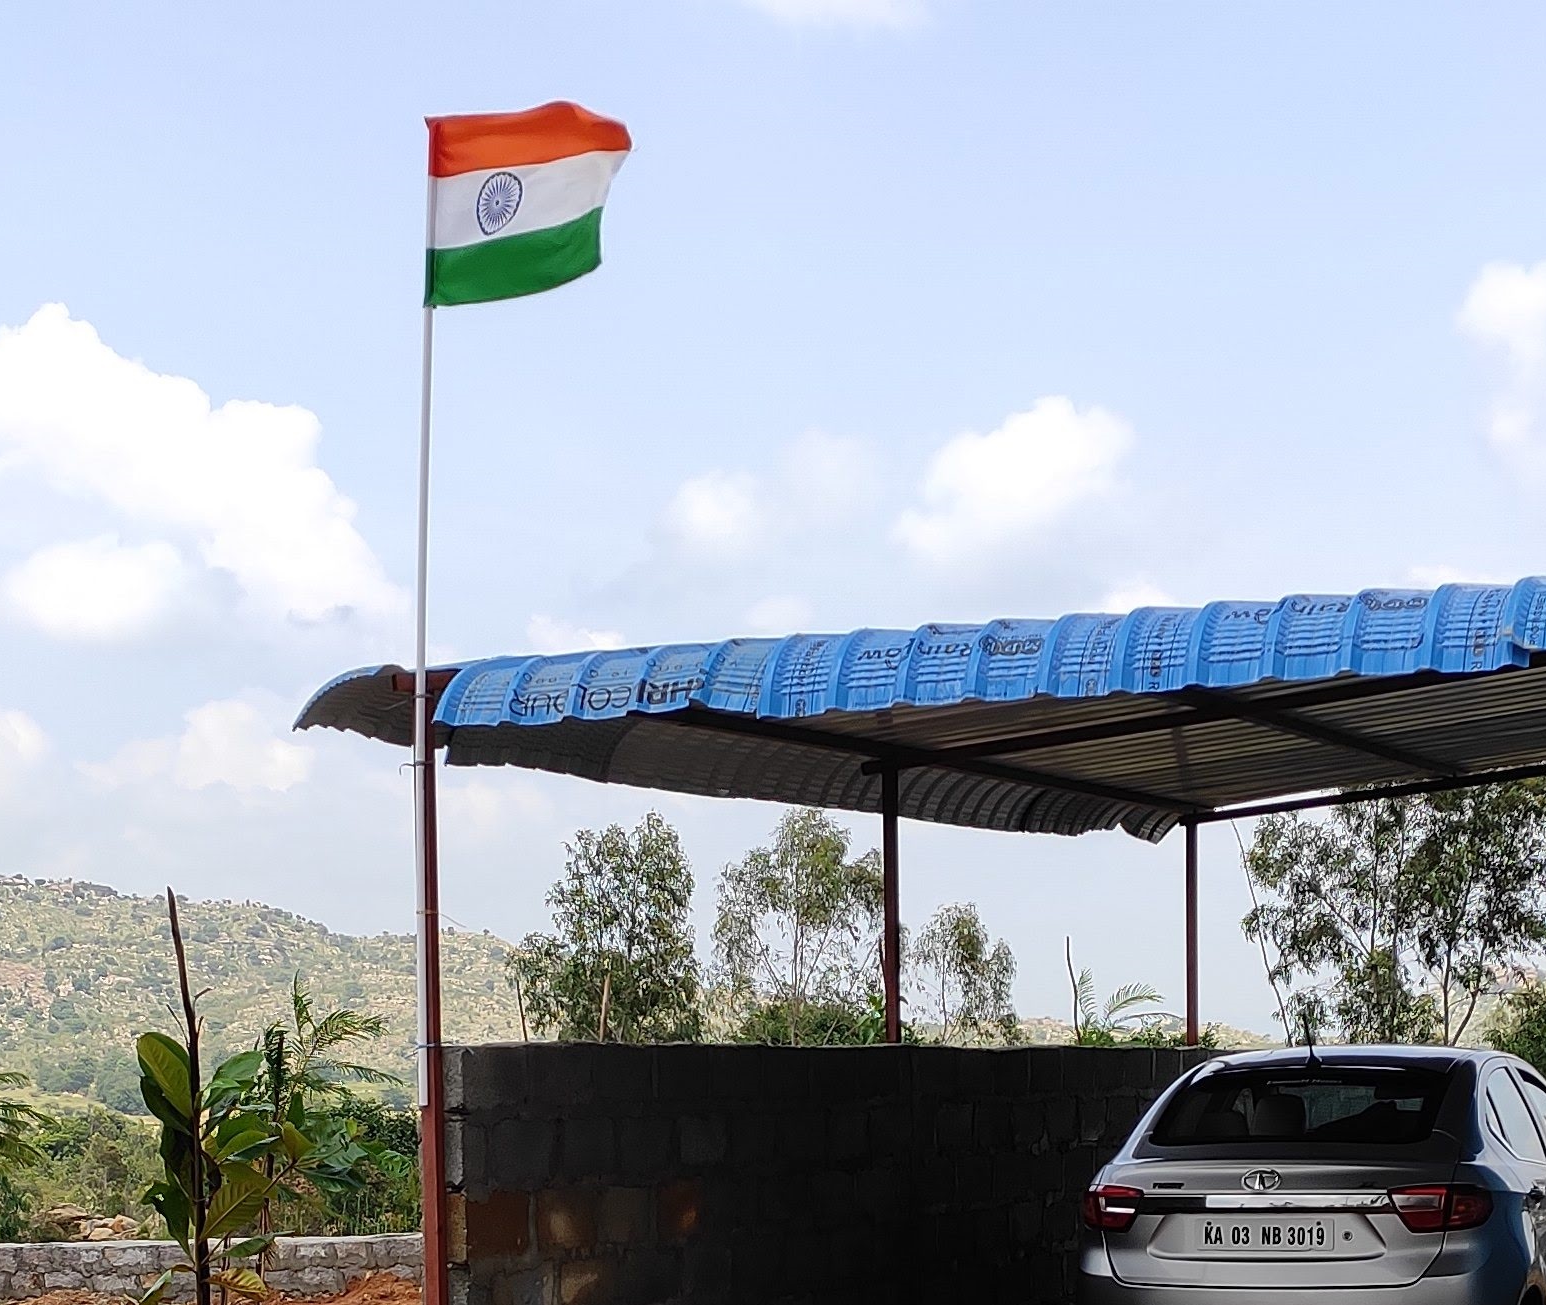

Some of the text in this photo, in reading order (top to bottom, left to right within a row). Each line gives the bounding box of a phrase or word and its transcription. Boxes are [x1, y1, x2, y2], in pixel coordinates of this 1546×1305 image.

[1204, 1226, 1325, 1246] KA 03 NB 3019
